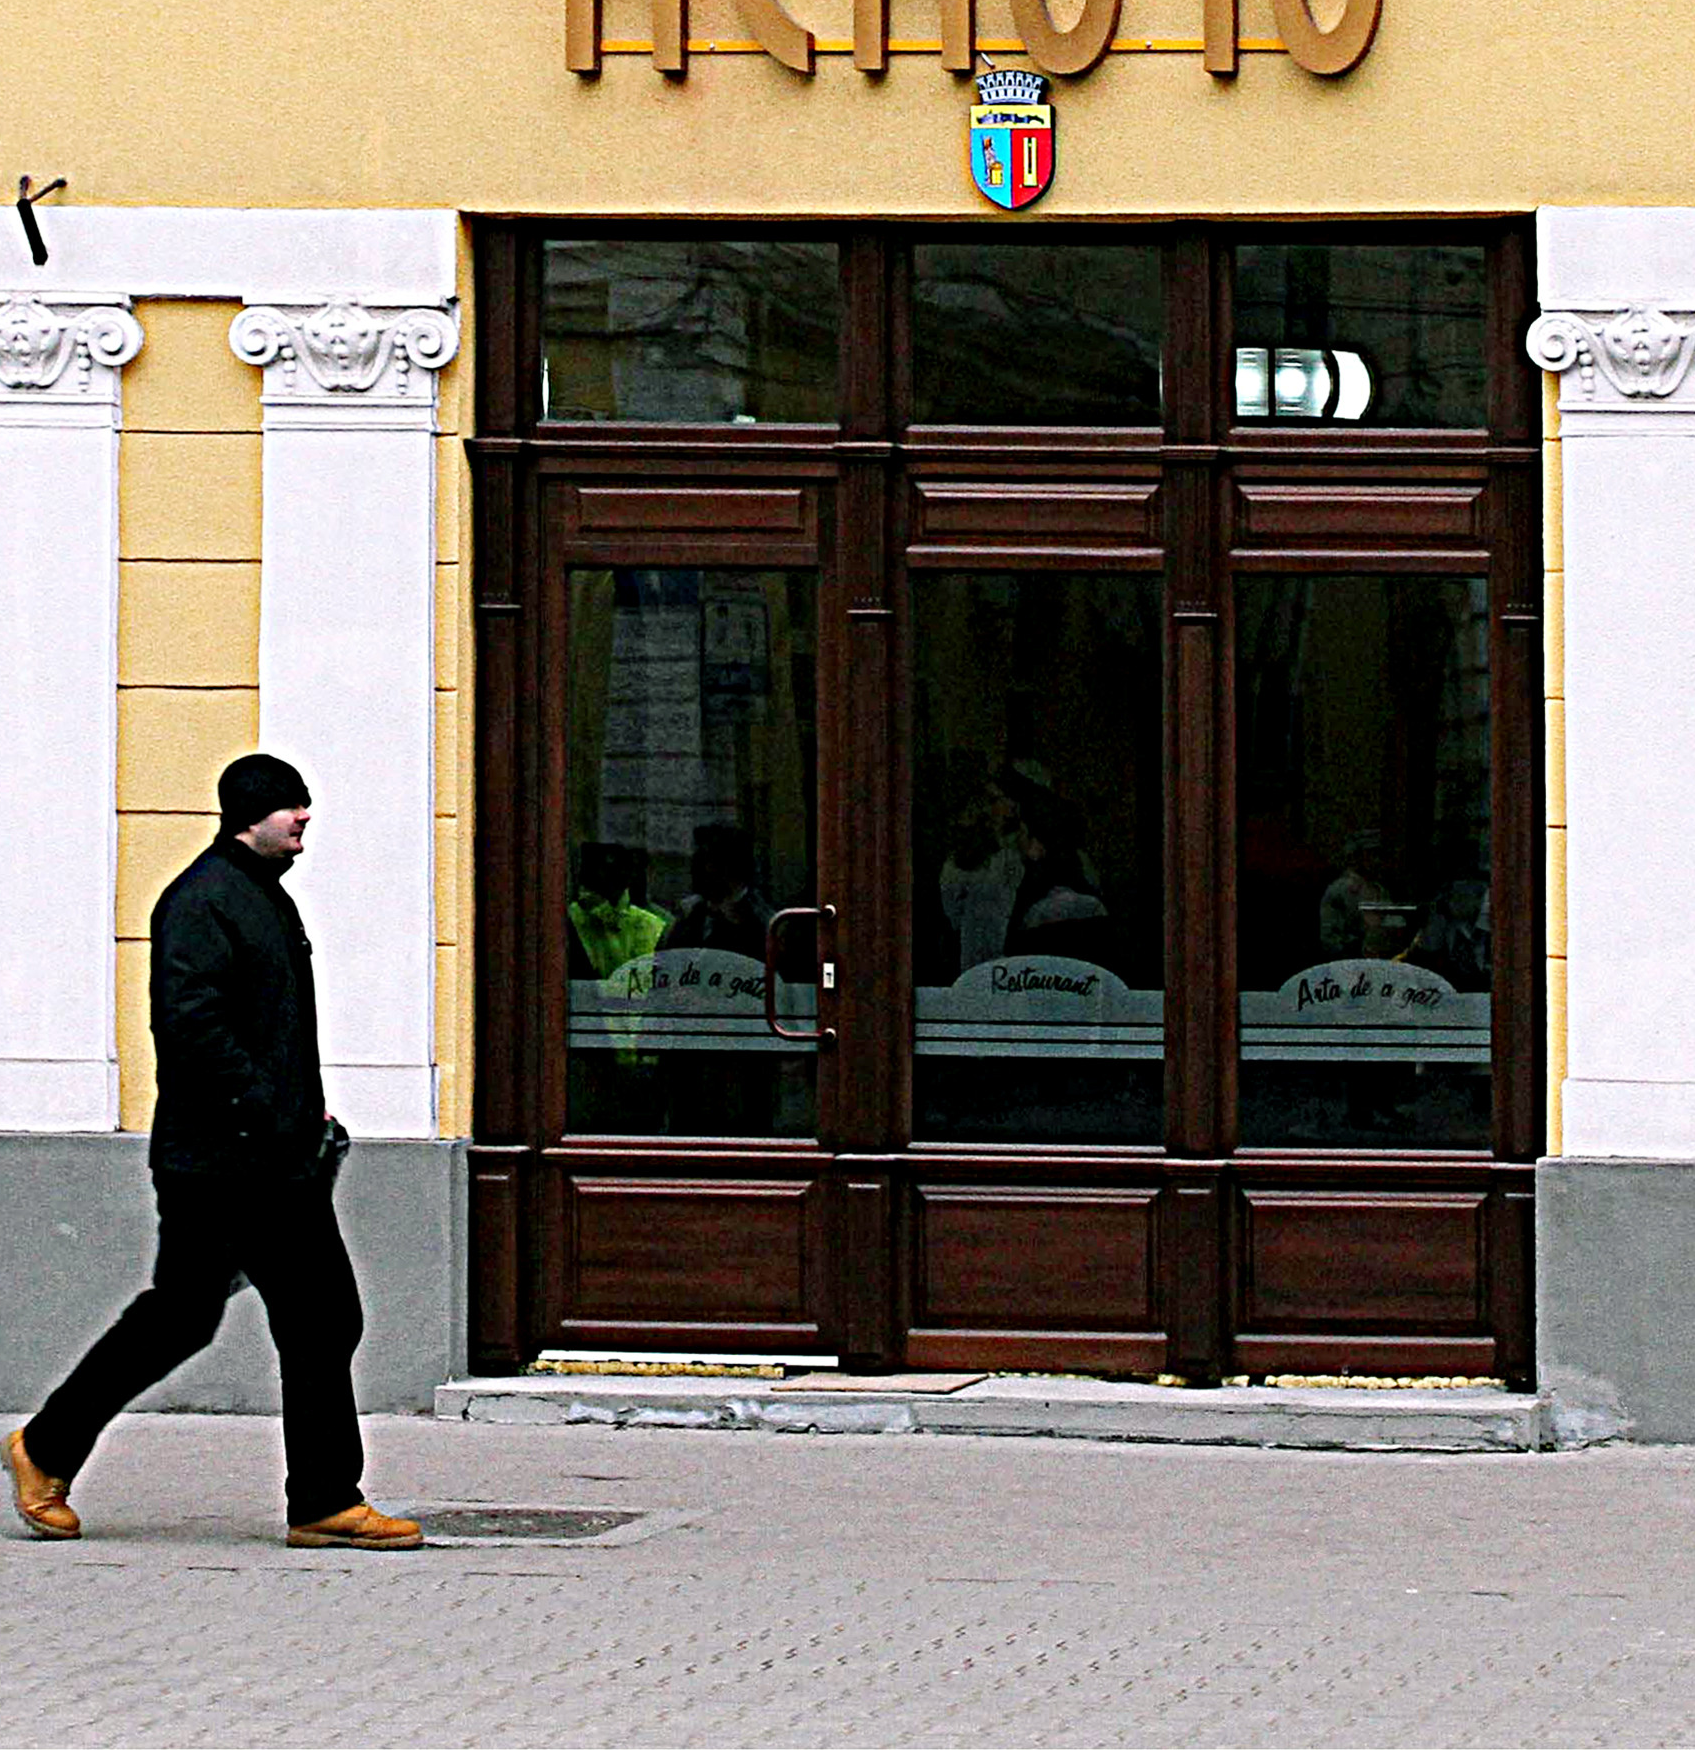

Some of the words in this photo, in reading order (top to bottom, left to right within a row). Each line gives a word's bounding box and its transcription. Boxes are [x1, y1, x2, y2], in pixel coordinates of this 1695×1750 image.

[708, 971, 722, 987] a
[992, 965, 1100, 997] Restaurant
[1298, 978, 1341, 1012] Arta
[1350, 973, 1371, 999] de
[1381, 983, 1394, 998] a
